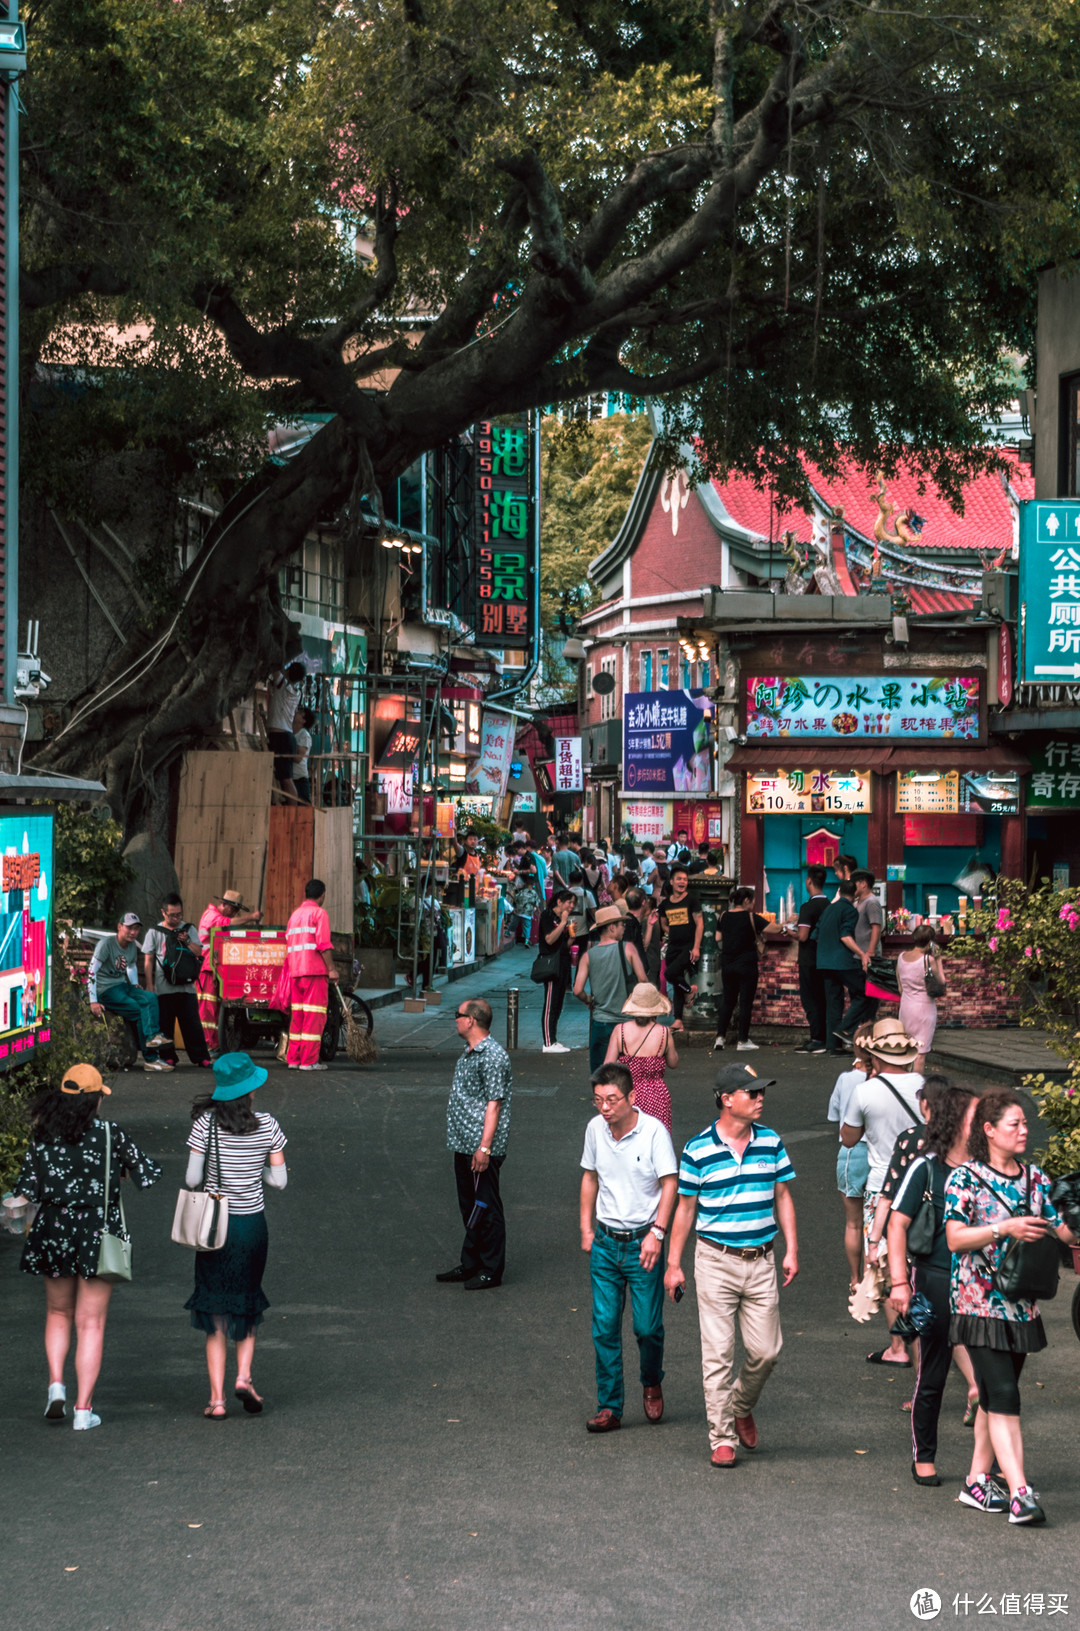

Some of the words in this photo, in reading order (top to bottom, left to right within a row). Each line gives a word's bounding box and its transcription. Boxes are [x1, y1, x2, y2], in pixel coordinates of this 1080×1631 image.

[490, 427, 528, 600] 港海景
[1048, 547, 1080, 653] 公共厕所
[482, 604, 527, 634] 别墅
[755, 683, 967, 712] 阿珍の水果小站
[760, 718, 827, 731] 鲜切水果
[901, 718, 973, 731] 现榨果汁
[483, 734, 505, 748] 美食
[558, 739, 573, 789] 百货超市
[1031, 772, 1080, 798] 寄存
